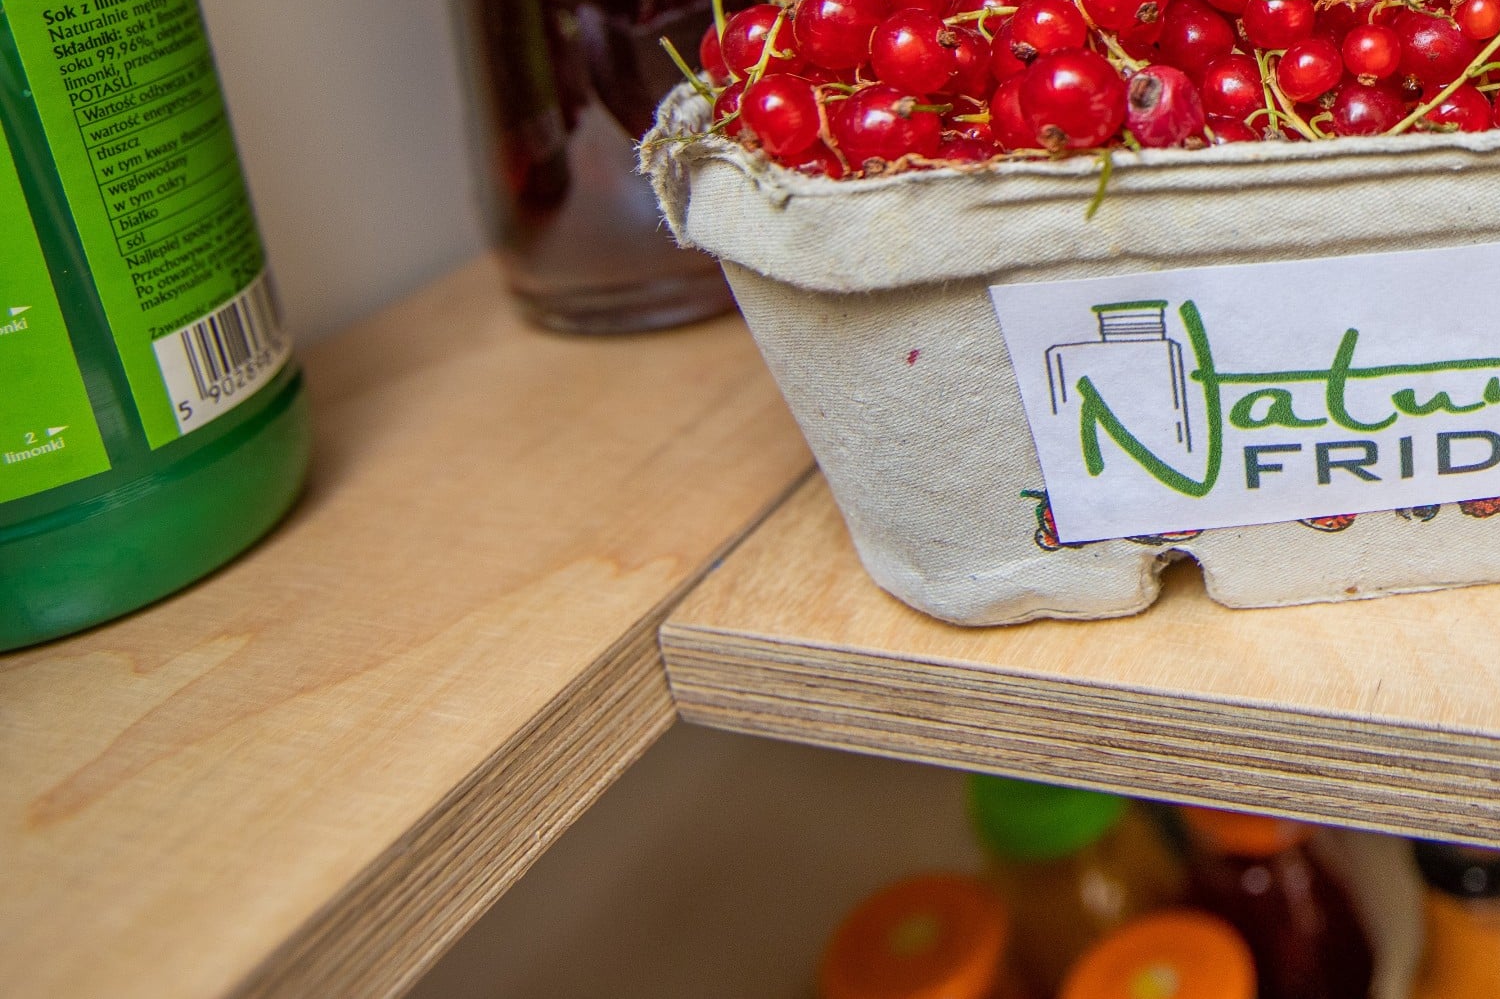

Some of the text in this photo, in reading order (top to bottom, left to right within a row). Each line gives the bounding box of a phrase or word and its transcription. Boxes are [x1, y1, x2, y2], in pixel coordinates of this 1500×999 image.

[43, 5, 77, 25] Sok
[81, 3, 90, 15] z
[48, 8, 128, 43] Naturalnie
[53, 29, 122, 60] Składniki:
[126, 19, 147, 37] sok
[60, 57, 94, 76] soku
[63, 63, 121, 91] limonki,
[68, 74, 137, 107] POTASU.
[83, 96, 136, 122] Wartość
[90, 115, 141, 142] wartość
[96, 136, 141, 161] tłuszcz
[102, 165, 114, 178] w
[118, 154, 143, 173] tym
[113, 174, 188, 213] w tym cukry
[119, 207, 159, 231] białko
[126, 232, 147, 250] sól
[136, 284, 154, 299] Po
[0, 317, 29, 336] onki
[178, 400, 193, 421] 5
[3, 437, 67, 465] limonki
[24, 432, 38, 446] 2
